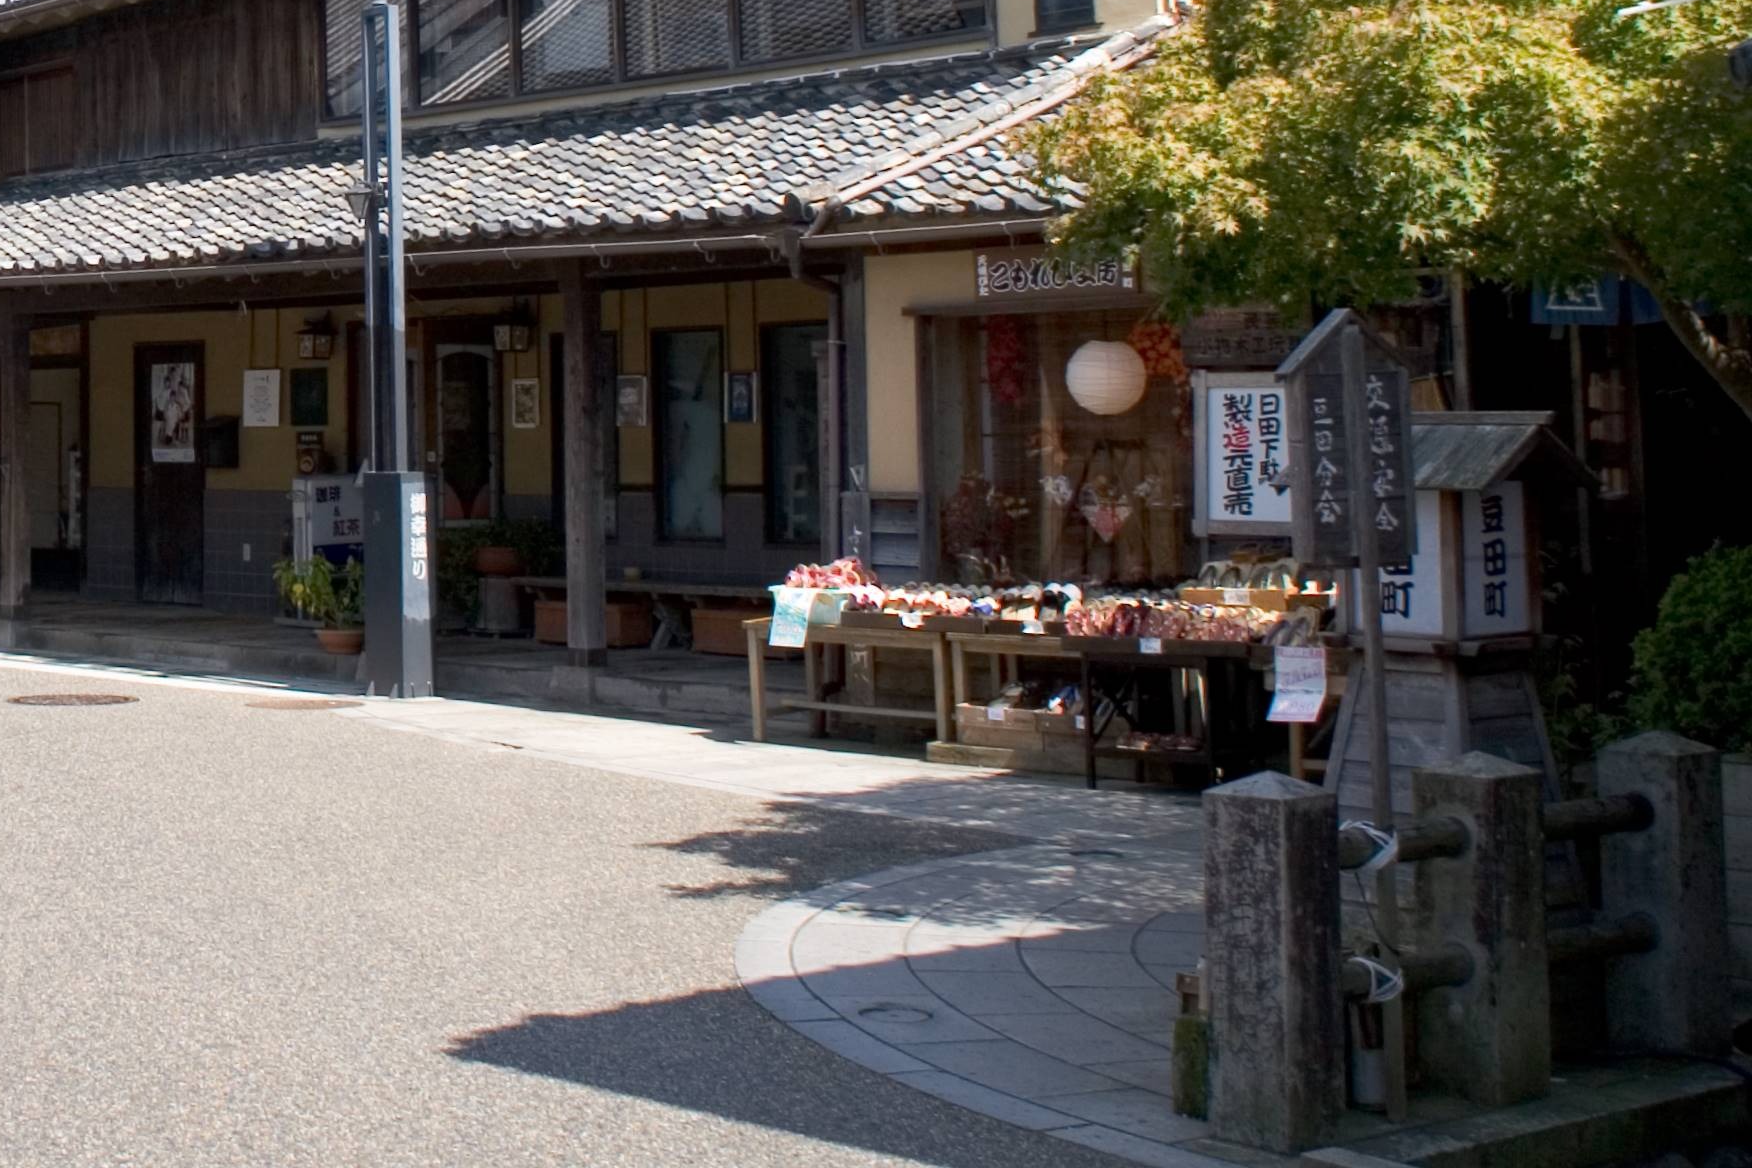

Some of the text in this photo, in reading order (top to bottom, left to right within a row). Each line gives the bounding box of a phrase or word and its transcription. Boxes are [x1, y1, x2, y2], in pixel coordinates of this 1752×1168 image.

[1222, 393, 1254, 516] 製造元直売
[1365, 373, 1400, 531] 交通安全
[333, 518, 360, 537] 紅茶
[1480, 494, 1507, 618] 豆田町
